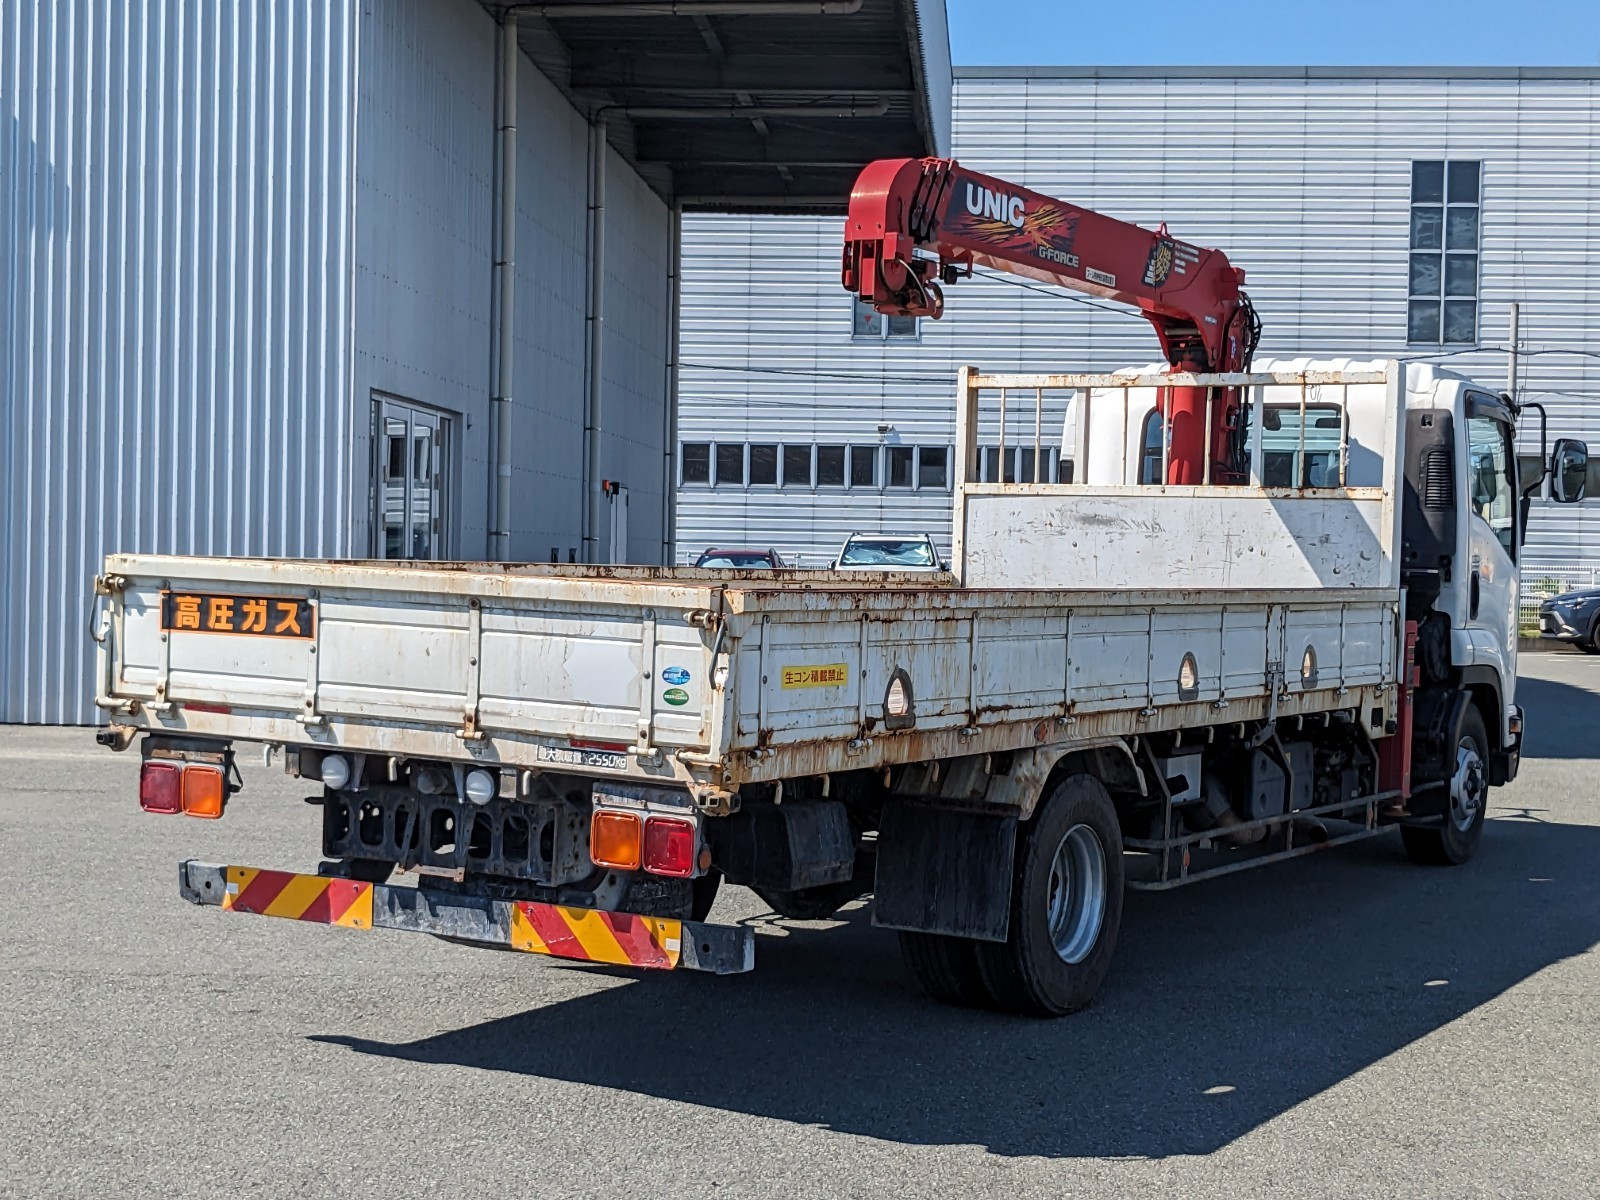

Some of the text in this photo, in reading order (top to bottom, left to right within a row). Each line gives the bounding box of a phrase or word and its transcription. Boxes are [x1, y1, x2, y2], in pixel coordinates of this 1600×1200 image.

[966, 183, 1025, 228] UNIC
[175, 595, 301, 635] 高圧ガス
